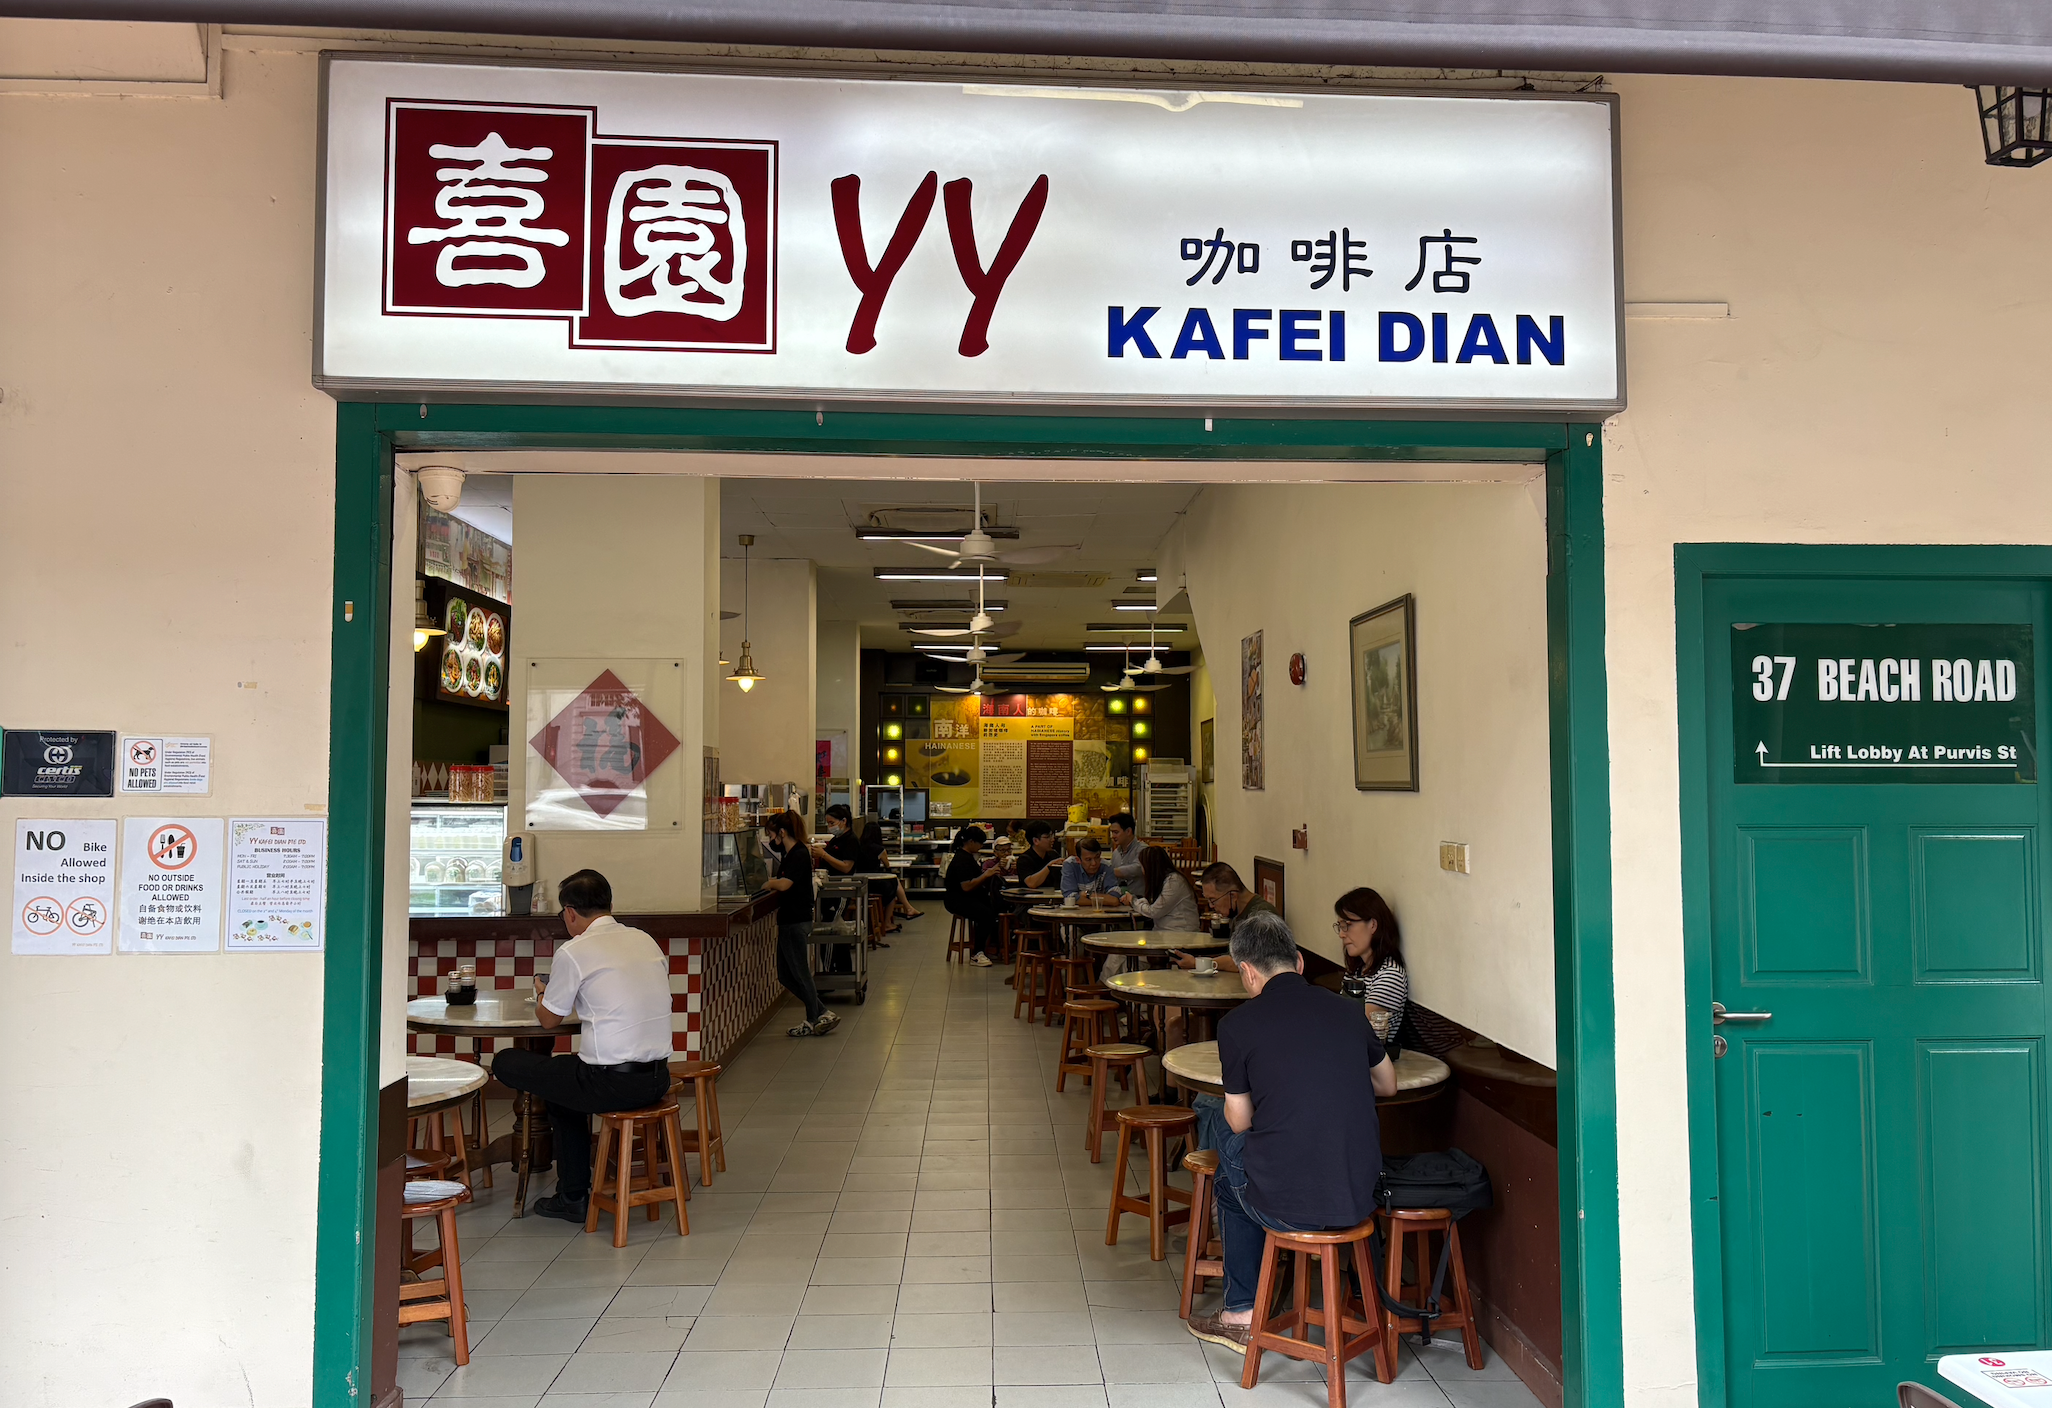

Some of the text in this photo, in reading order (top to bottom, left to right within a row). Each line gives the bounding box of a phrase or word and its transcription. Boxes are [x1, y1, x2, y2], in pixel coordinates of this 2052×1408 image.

[1180, 227, 1482, 293] 咖啡店
[1107, 306, 1565, 366] KAFEI DIAN
[1751, 655, 2016, 702] 37 BEACH ROAD
[934, 718, 969, 738] 南洋
[40, 735, 78, 744] Protected by
[925, 742, 975, 750] HAINANESE
[1810, 744, 2017, 762] Lift Lobby At Purvis St
[129, 768, 156, 777] NO PETS
[127, 779, 157, 788] ALLOWED
[26, 831, 66, 850] NO
[83, 843, 107, 852] Bike
[60, 858, 106, 867] Allowed
[21, 873, 106, 884] Inside the shop
[139, 904, 202, 913] 自备食物或饮料
